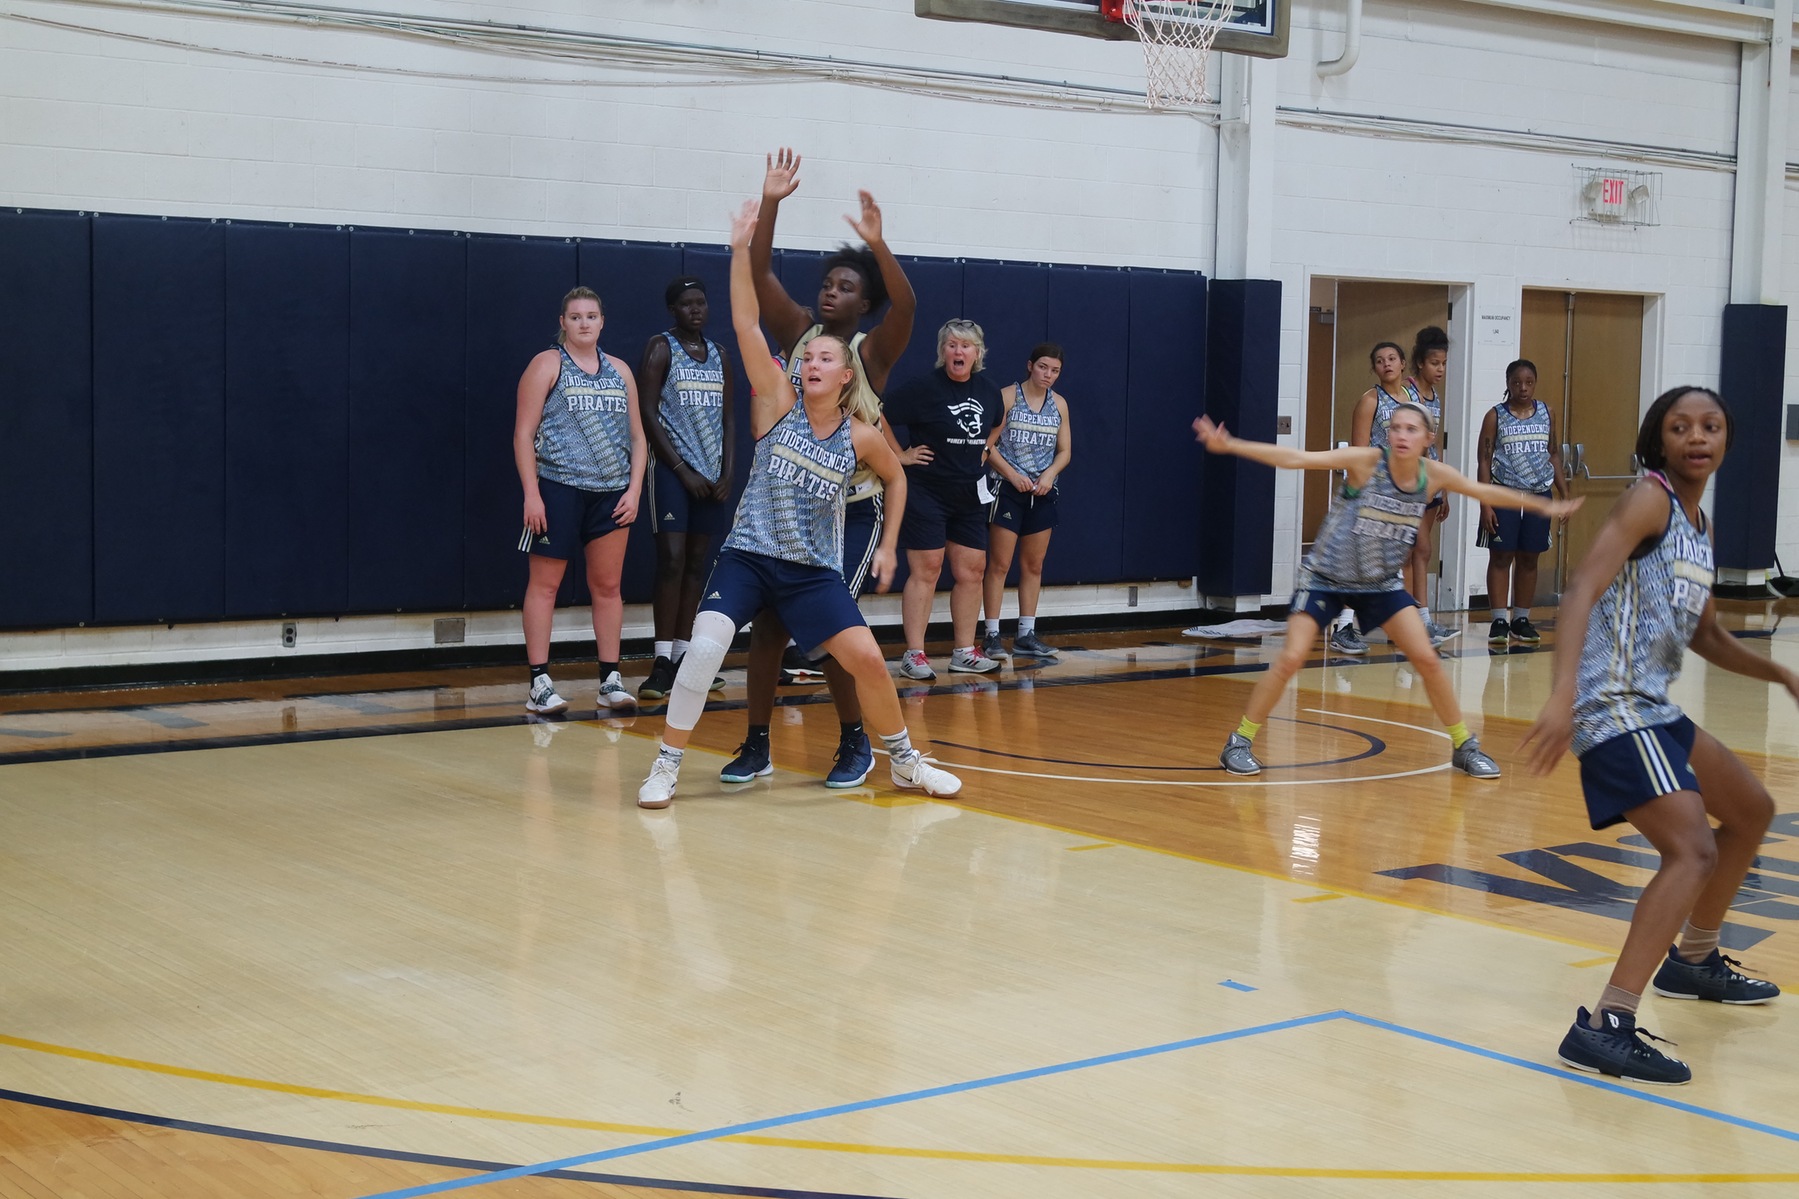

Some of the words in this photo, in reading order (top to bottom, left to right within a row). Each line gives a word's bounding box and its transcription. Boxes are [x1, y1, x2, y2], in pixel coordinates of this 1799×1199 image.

[1603, 179, 1624, 204] EXIT
[567, 395, 627, 413] PIRATES
[679, 390, 723, 406] PIRATE
[778, 428, 849, 472] INDEPENDENCE
[767, 455, 838, 500] PIRATES
[1351, 517, 1418, 545] PIRATE
